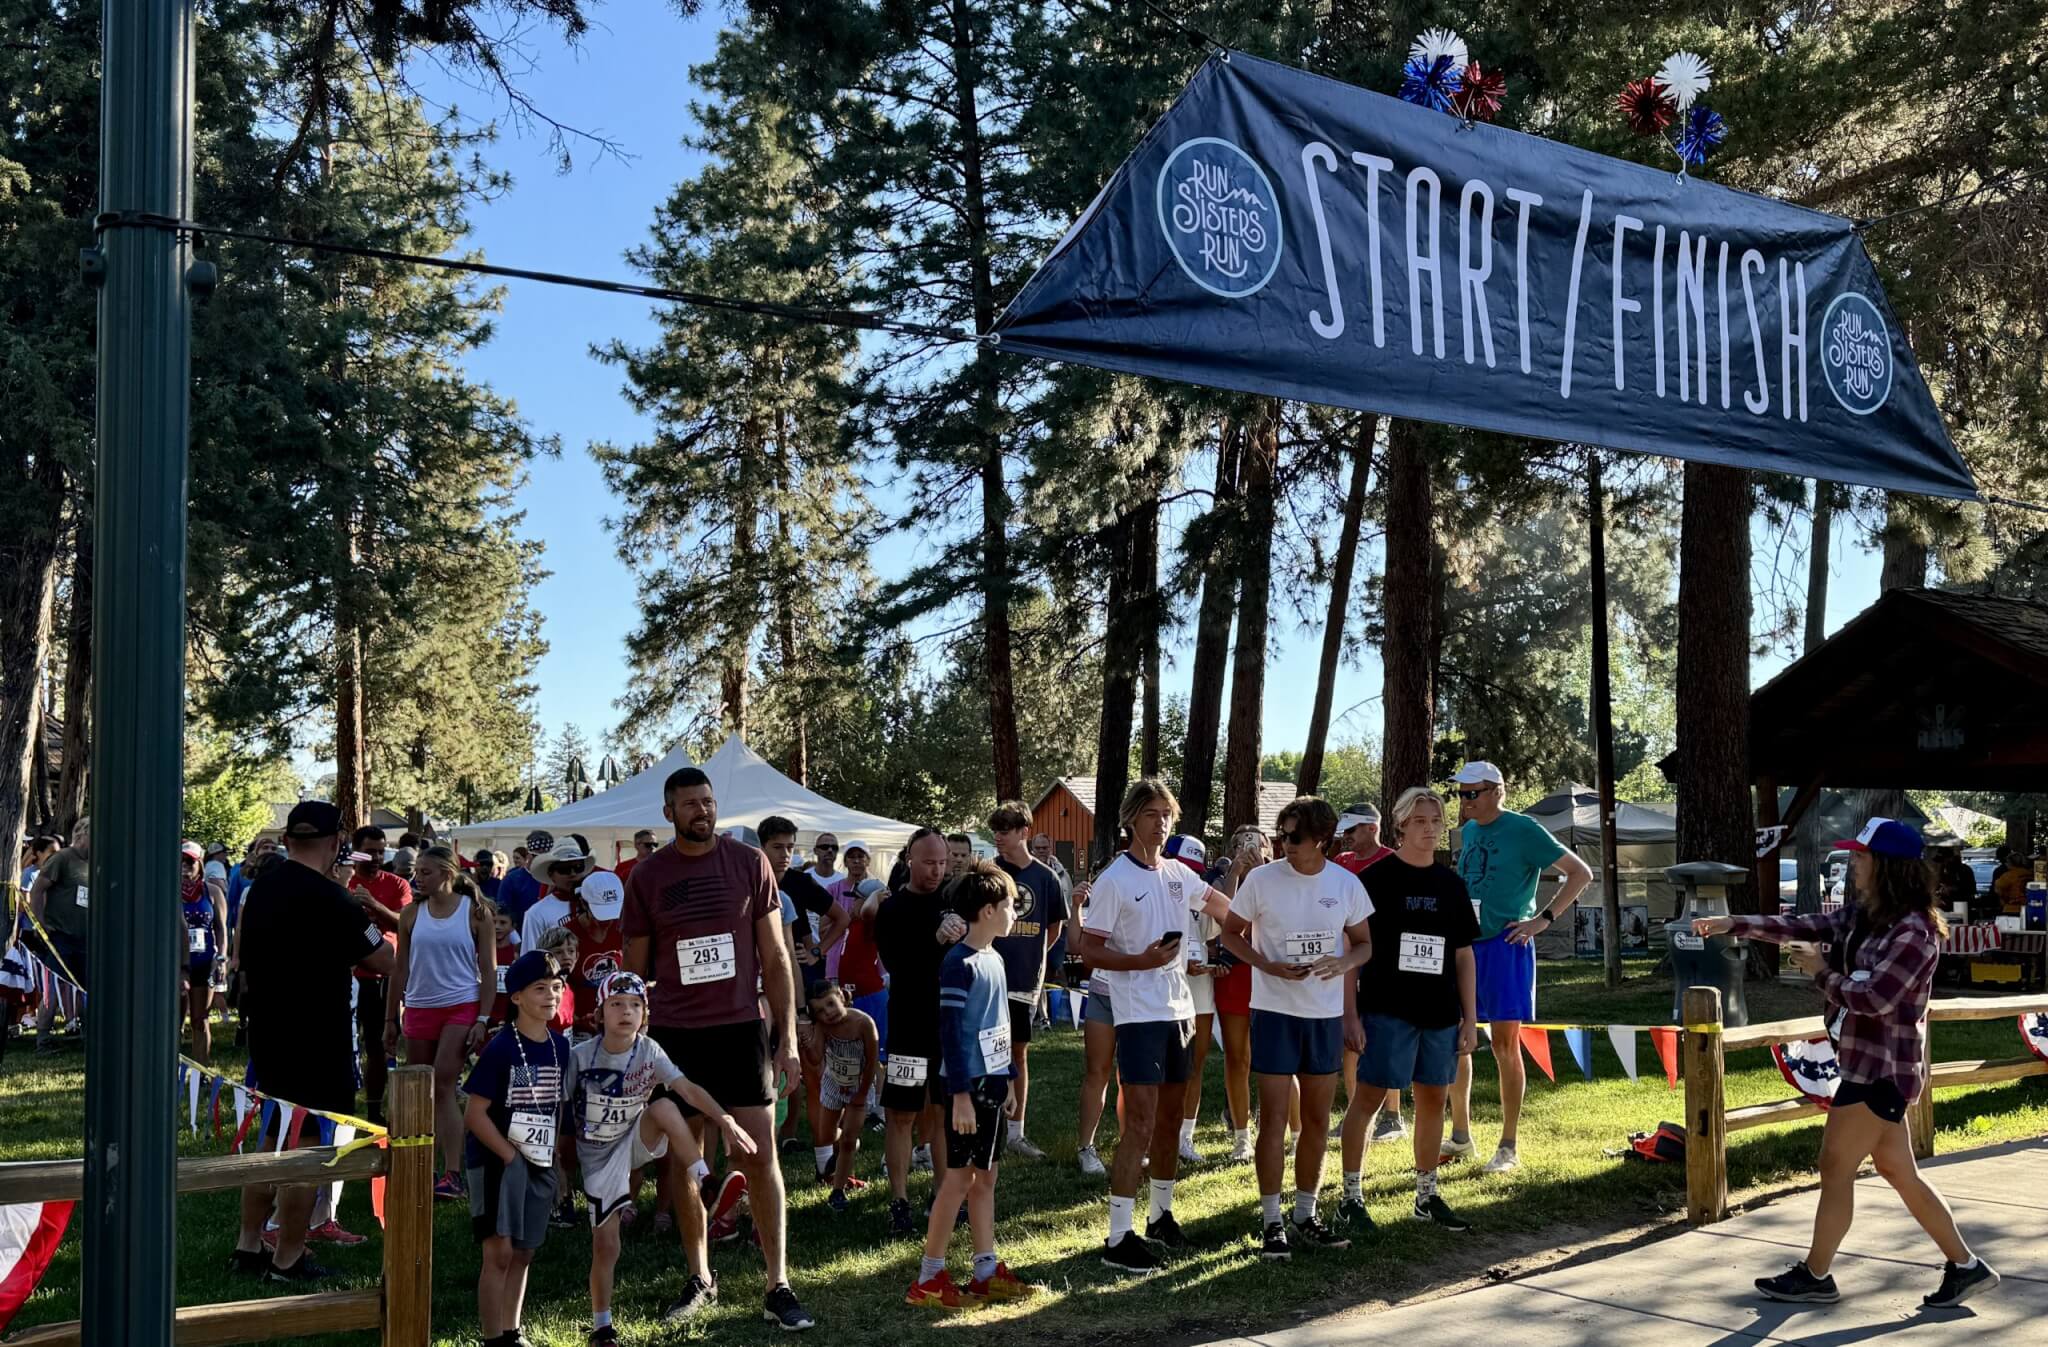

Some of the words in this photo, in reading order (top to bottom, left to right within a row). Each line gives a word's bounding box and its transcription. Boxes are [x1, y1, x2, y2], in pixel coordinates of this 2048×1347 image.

[1186, 159, 1234, 203] RUN
[1199, 232, 1248, 278] RUN
[1838, 309, 1865, 342] RUN
[1843, 365, 1873, 399] RUN
[693, 947, 719, 964] 293
[1301, 941, 1322, 954] 193
[1413, 944, 1433, 958] 194
[896, 1065, 914, 1079] 201
[602, 1107, 627, 1123] 241
[525, 1127, 549, 1145] 240
